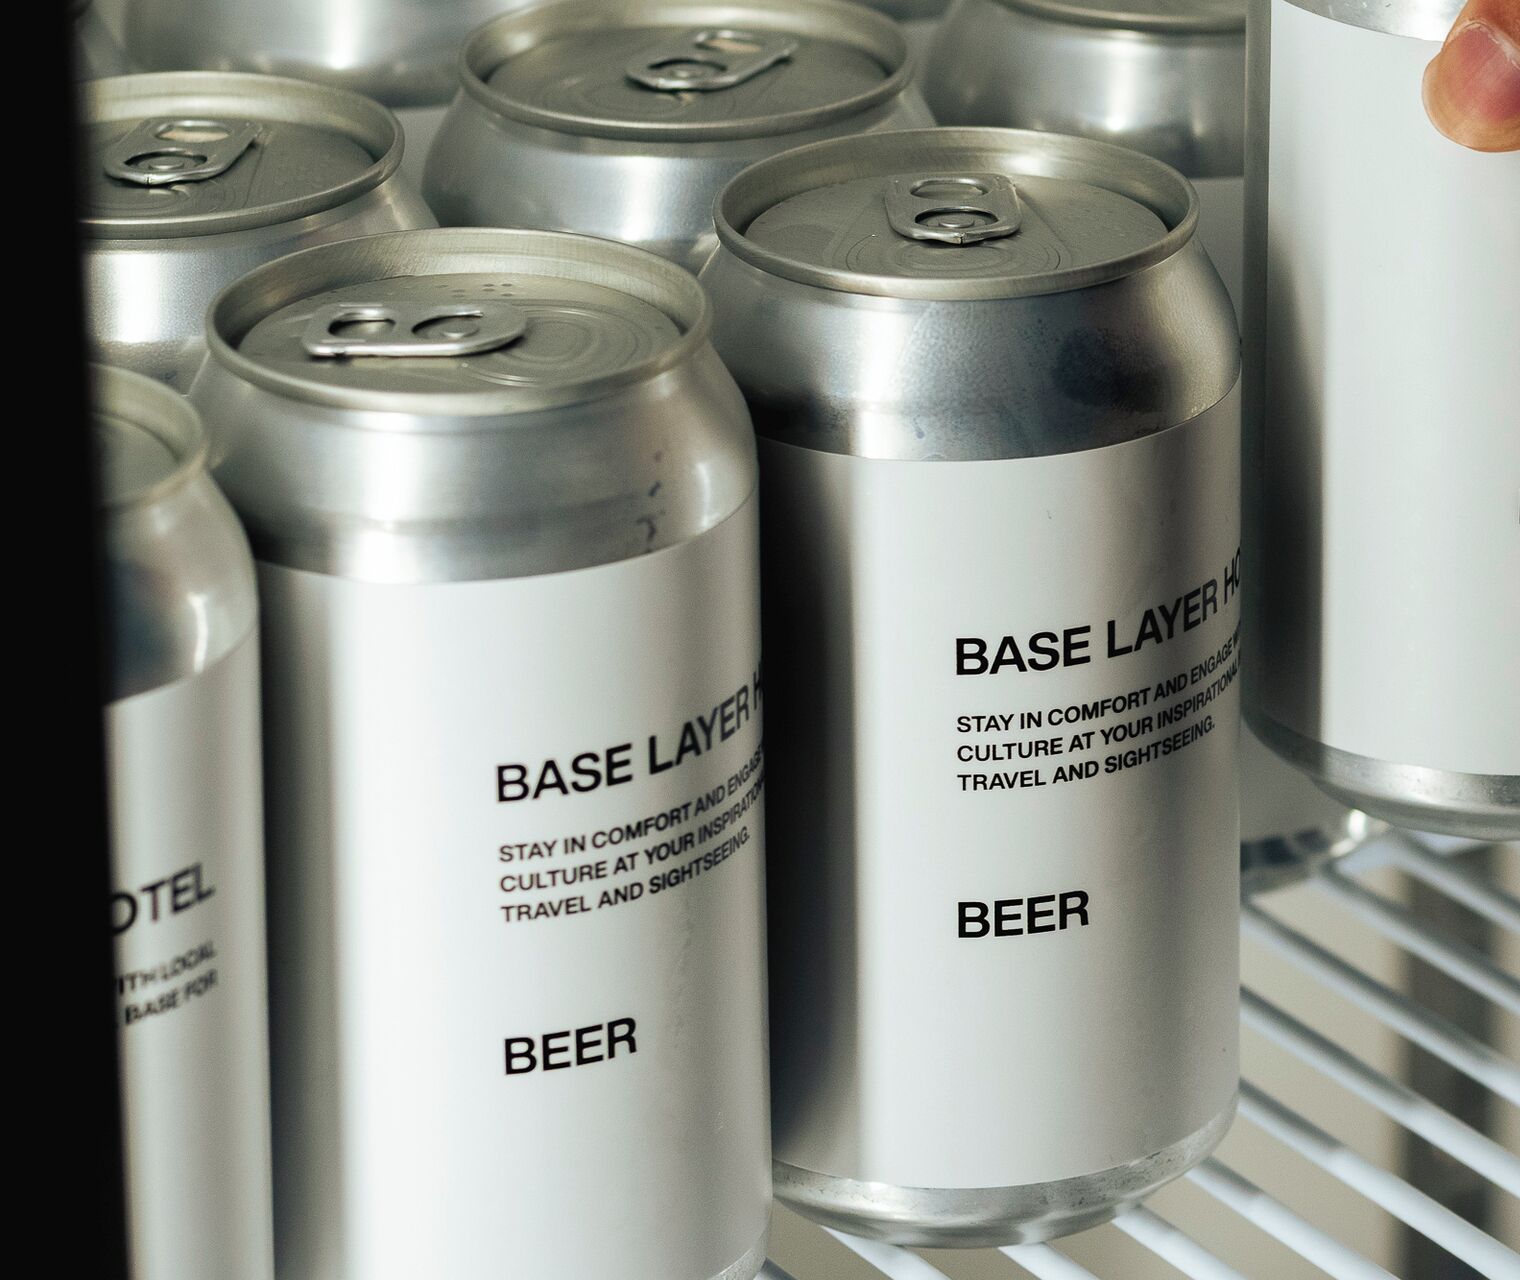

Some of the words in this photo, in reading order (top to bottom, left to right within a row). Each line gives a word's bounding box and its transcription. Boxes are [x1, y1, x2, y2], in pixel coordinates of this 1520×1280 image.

[956, 625, 1091, 675] BASE
[1107, 579, 1218, 658] LAYER
[957, 713, 1014, 733] STAY
[1020, 711, 1042, 730] IN
[1048, 687, 1151, 726] COMFORT
[1153, 673, 1188, 702] AND
[1190, 637, 1233, 685] ENGAGE
[497, 743, 633, 803] BASE
[649, 684, 749, 775] LAYER
[957, 737, 1063, 762] CULTURE
[1069, 732, 1095, 753] AT
[1101, 716, 1153, 745] YOUR
[957, 770, 1046, 791] TRAVEL
[1053, 760, 1099, 783] AND
[1105, 714, 1216, 774] SIGHTSEEING.
[500, 840, 557, 862] STAY
[564, 835, 586, 855] IN
[592, 802, 692, 849] COMFORT
[695, 786, 725, 816] AND
[108, 862, 216, 936] OTEL
[500, 861, 608, 893] CULTURE
[613, 852, 639, 874] AT
[645, 832, 695, 864] YOUR
[502, 896, 591, 922] TRAVEL
[598, 882, 643, 908] AND
[650, 826, 750, 894] SIGHTSEEING.
[958, 890, 1089, 938] BEER
[505, 1017, 637, 1075] BEER
